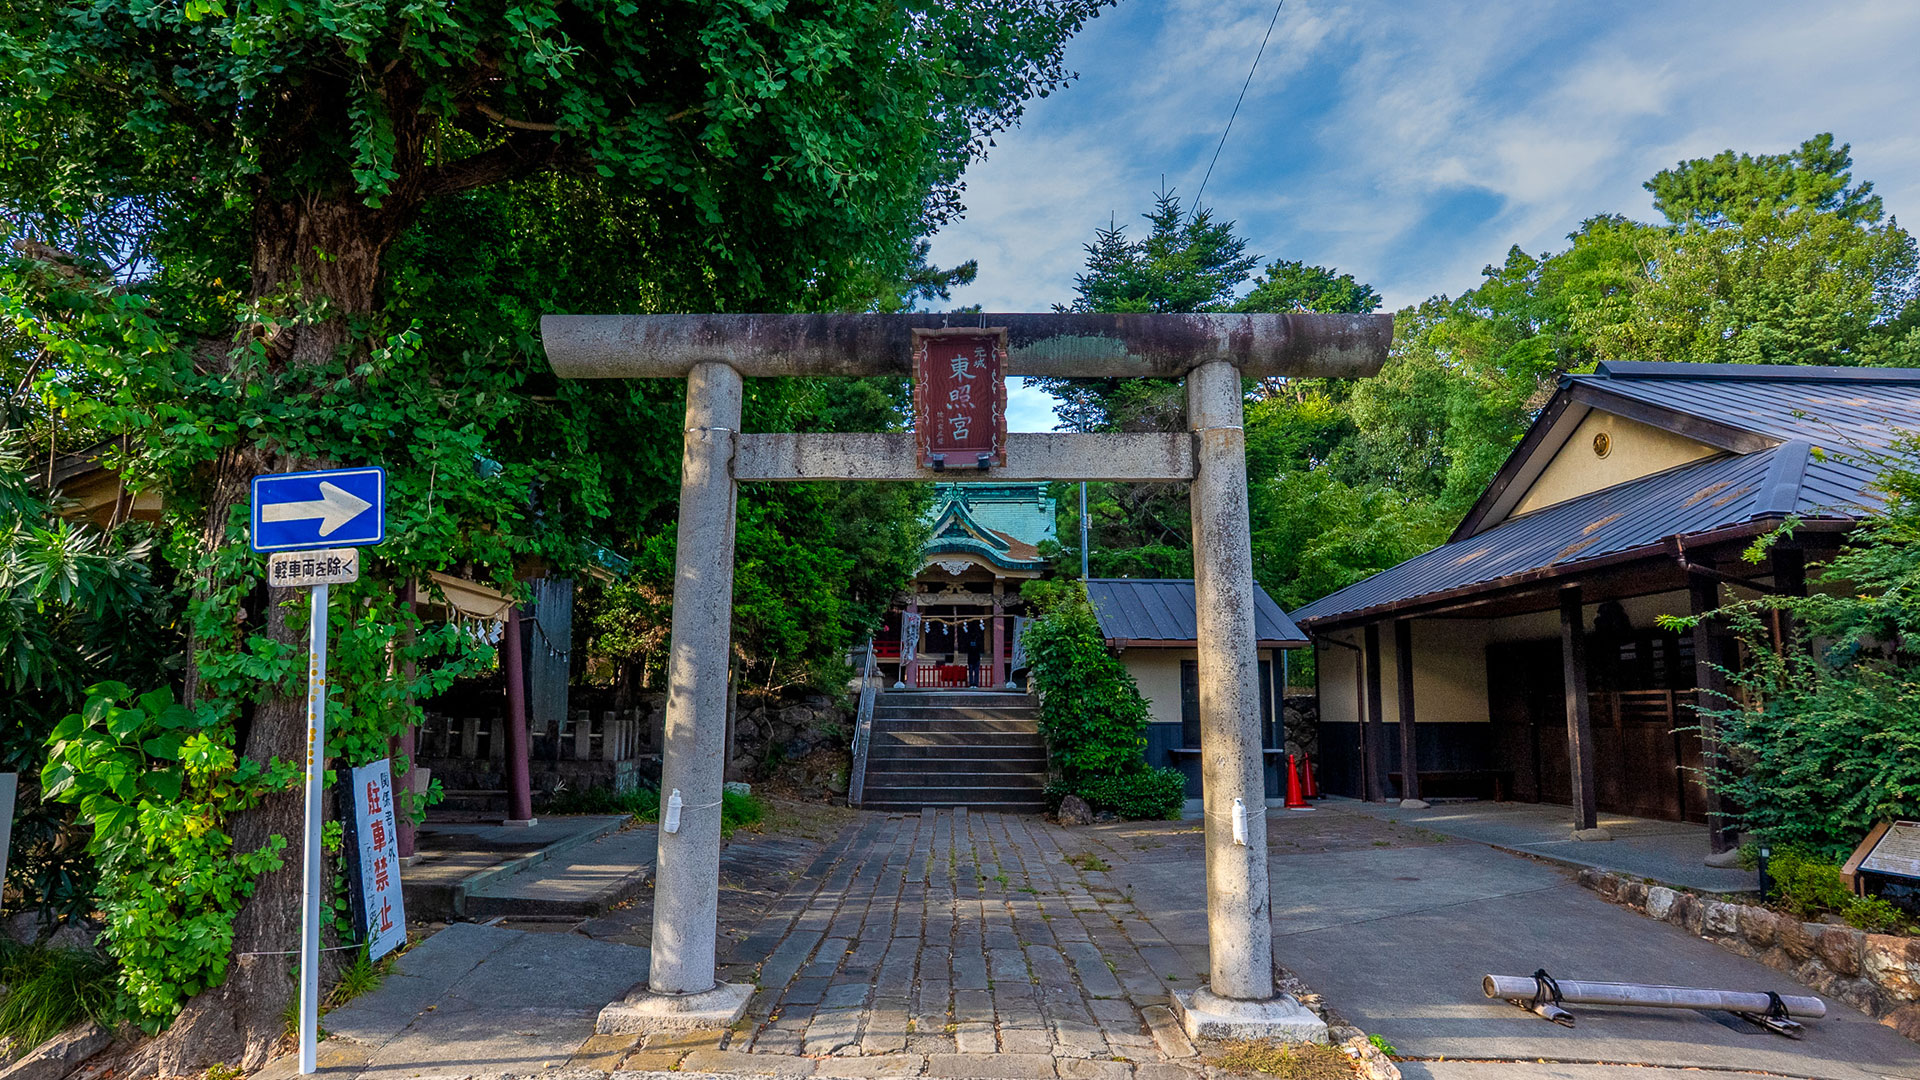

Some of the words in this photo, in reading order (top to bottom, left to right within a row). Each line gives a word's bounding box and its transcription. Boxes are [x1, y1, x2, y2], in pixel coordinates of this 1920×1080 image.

[946, 354, 976, 440] 東照宮
[274, 556, 353, 579] 軽車両を除く
[367, 780, 393, 932] 駐車禁止
